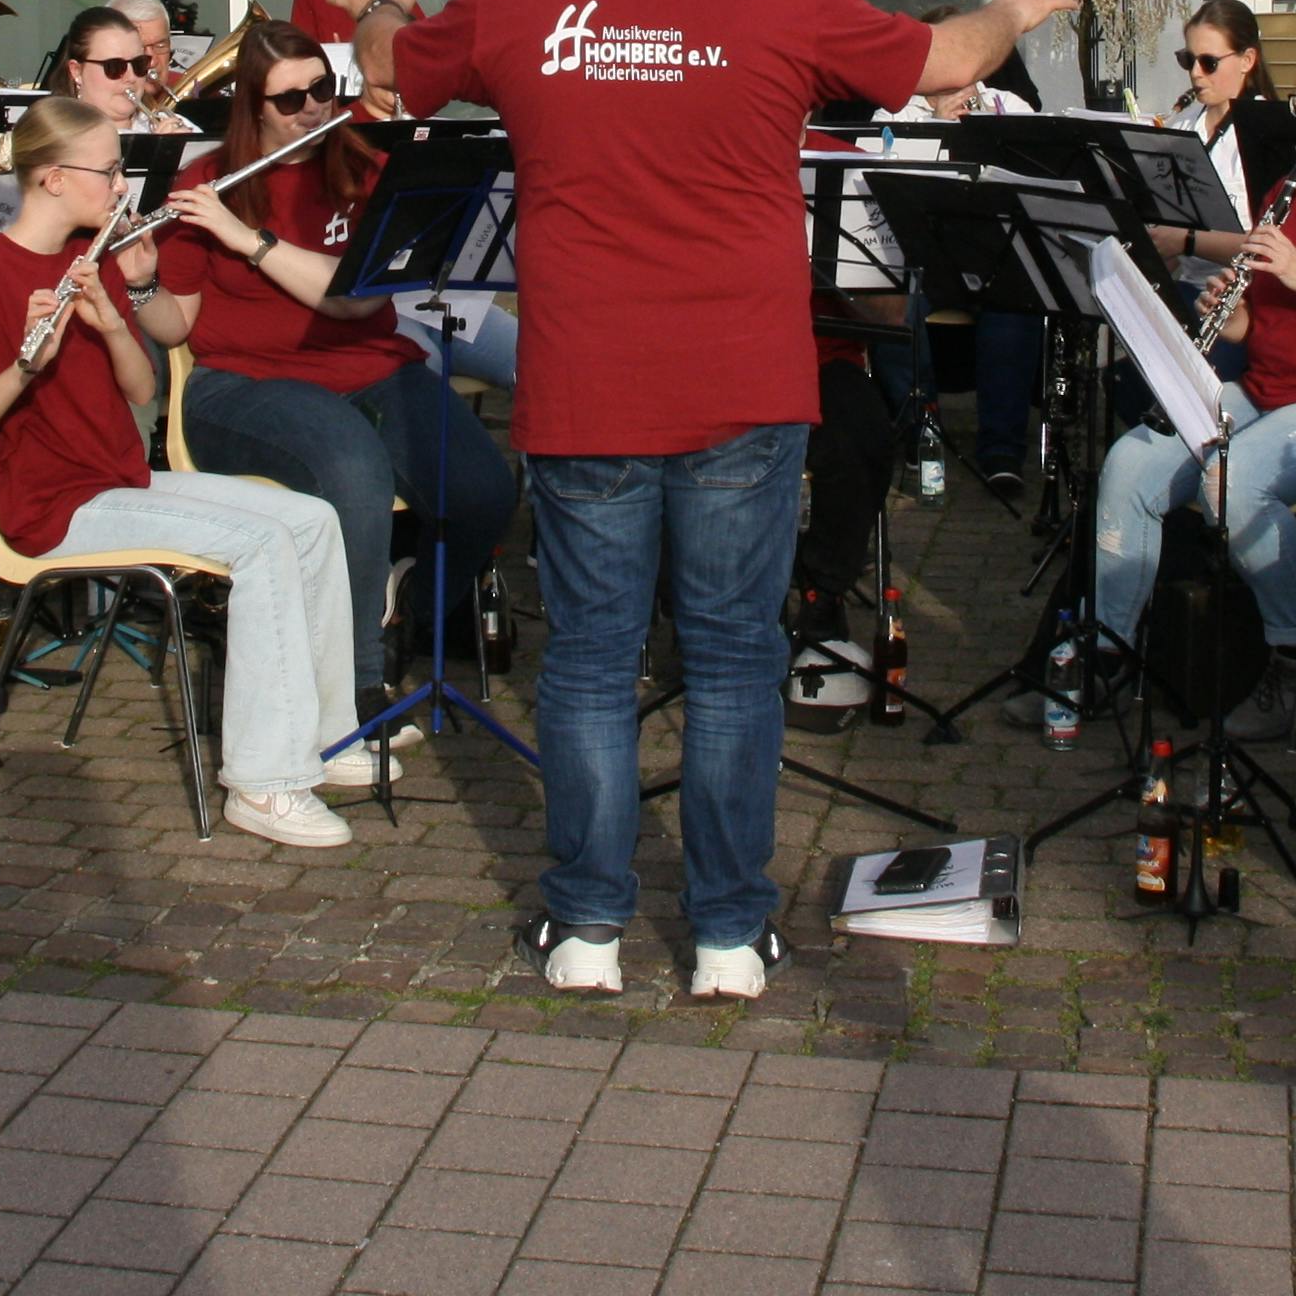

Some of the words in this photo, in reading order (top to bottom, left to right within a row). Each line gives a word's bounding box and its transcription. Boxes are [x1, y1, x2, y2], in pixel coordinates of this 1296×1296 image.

[602, 26, 683, 42] Musikverein
[585, 43, 683, 65] HOHBERG
[688, 46, 728, 67] e.V.
[585, 64, 683, 82] Plüderhausen
